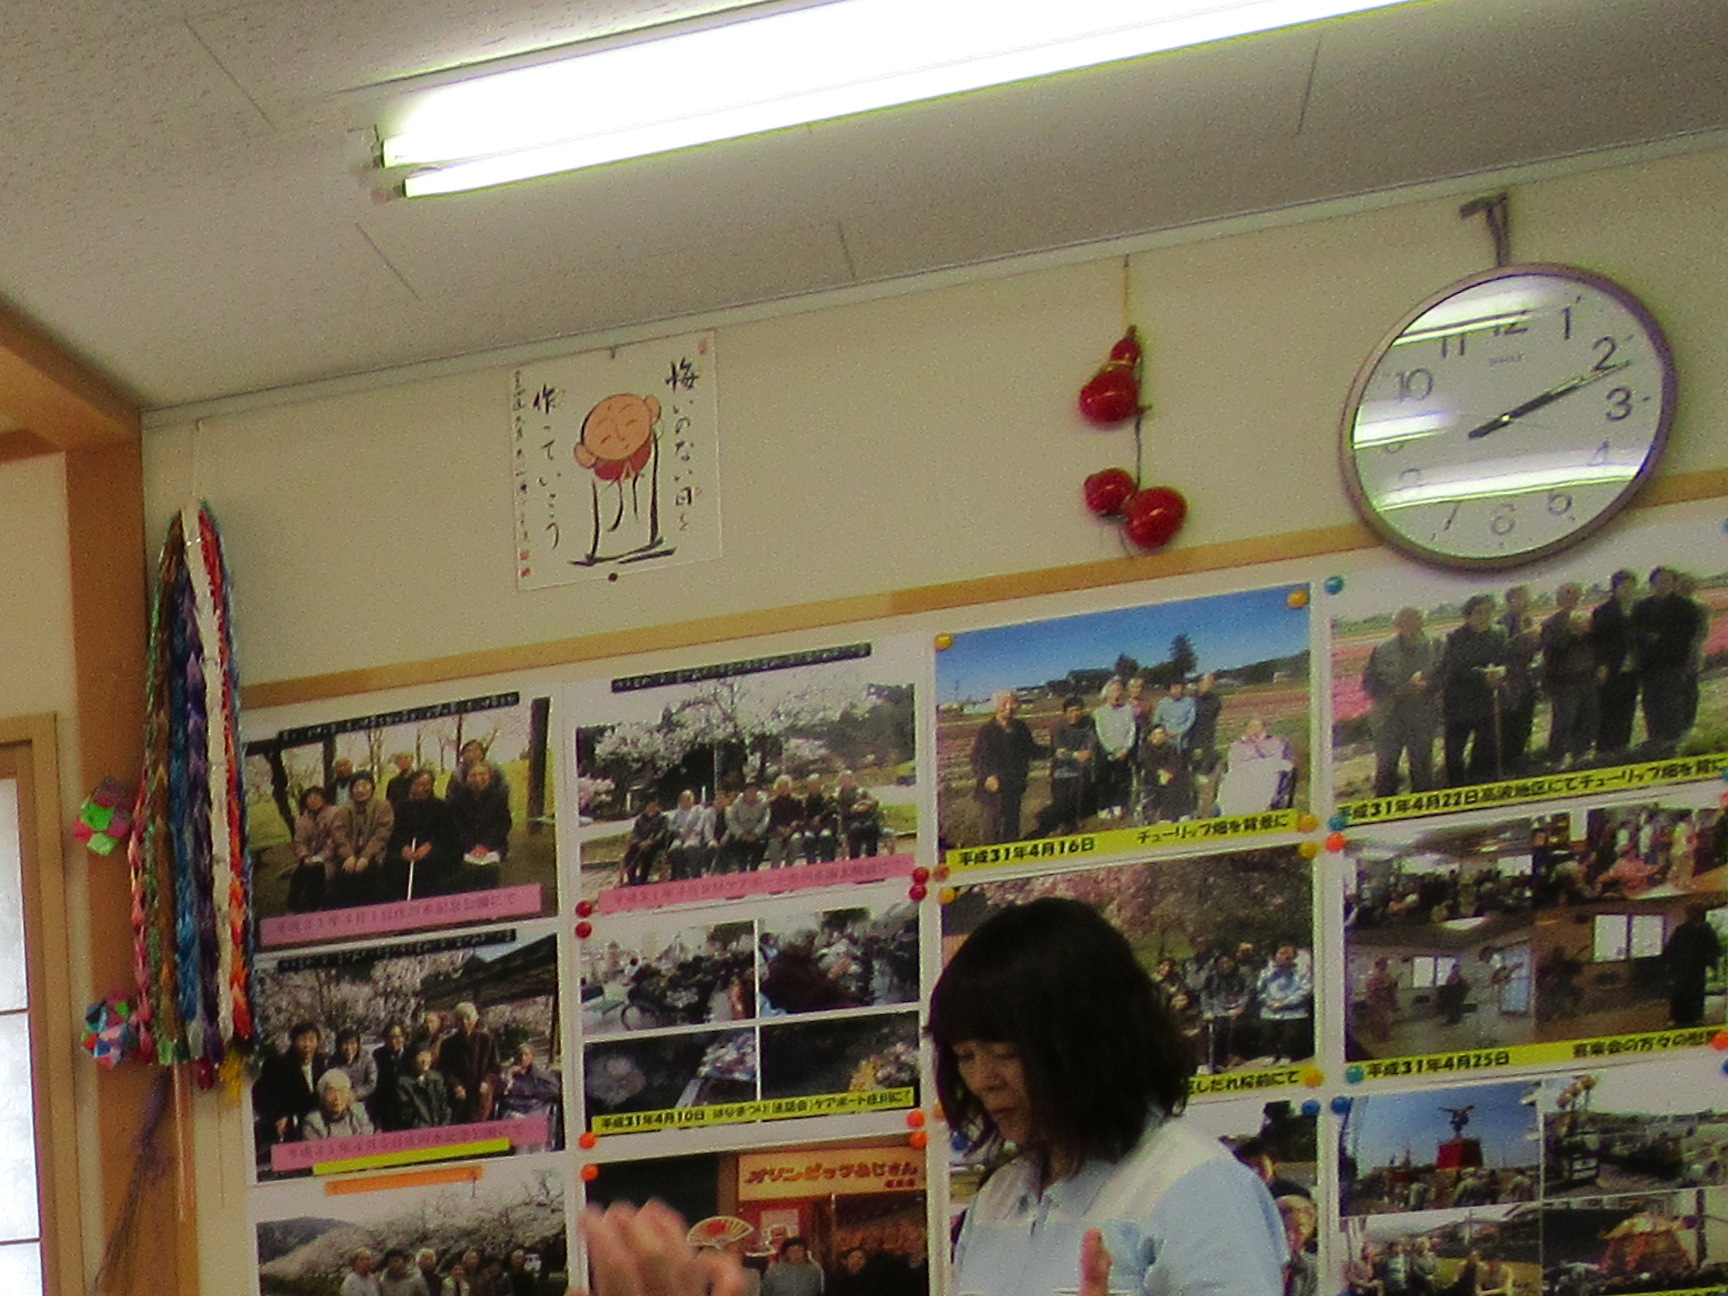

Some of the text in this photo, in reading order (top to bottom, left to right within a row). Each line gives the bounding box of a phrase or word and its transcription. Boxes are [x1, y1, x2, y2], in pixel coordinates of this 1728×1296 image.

[1562, 306, 1572, 340] 1
[1591, 336, 1617, 372] 2
[1396, 367, 1434, 402] 10
[1605, 387, 1632, 422] 3
[957, 836, 1095, 867] 平成31年4月16日
[1366, 1052, 1510, 1078] 平成31年4月25日
[601, 1109, 705, 1130] 平成31年4月10日
